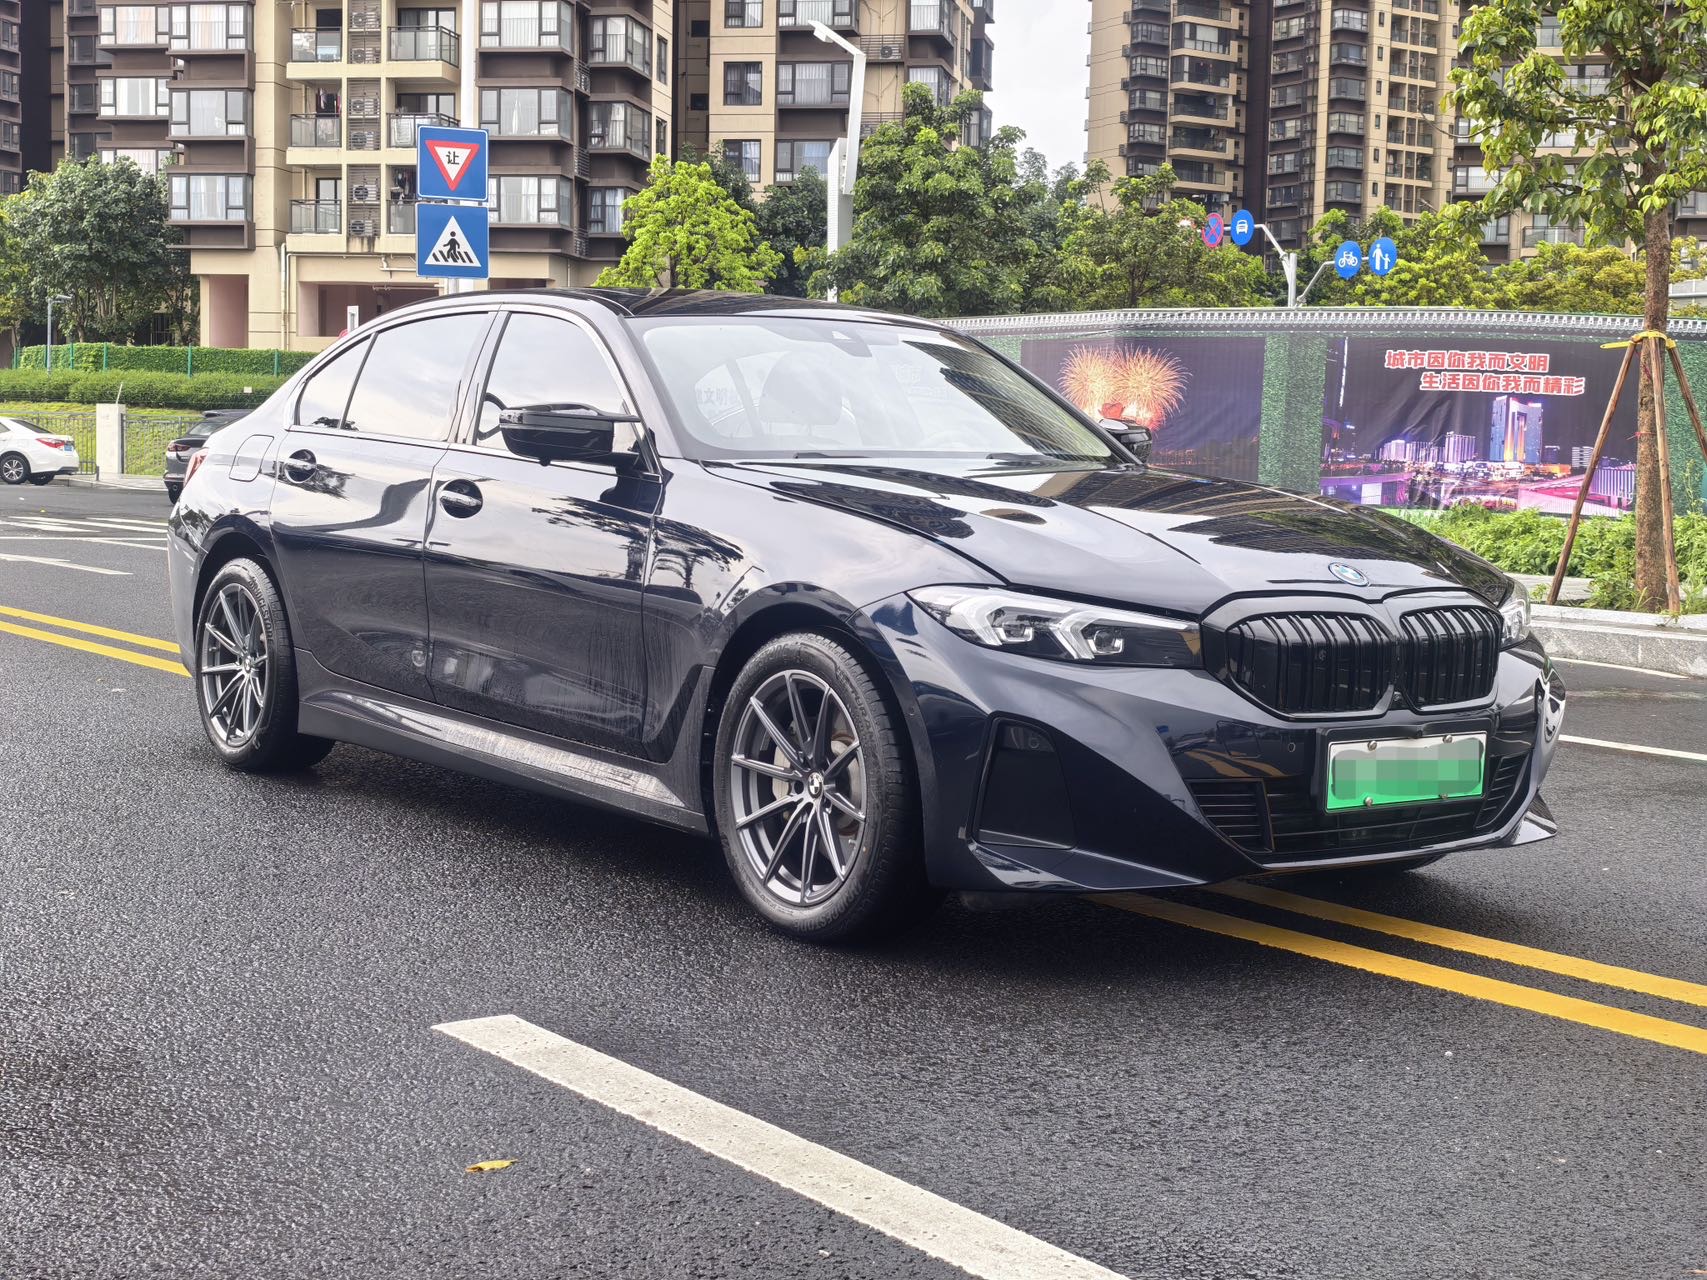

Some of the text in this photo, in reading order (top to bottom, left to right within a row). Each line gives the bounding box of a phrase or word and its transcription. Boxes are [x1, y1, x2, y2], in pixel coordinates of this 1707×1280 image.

[445, 151, 460, 165] 让
[1385, 350, 1550, 372] 城市因你我而文明
[1420, 372, 1585, 396] 生活因你我而精彩
